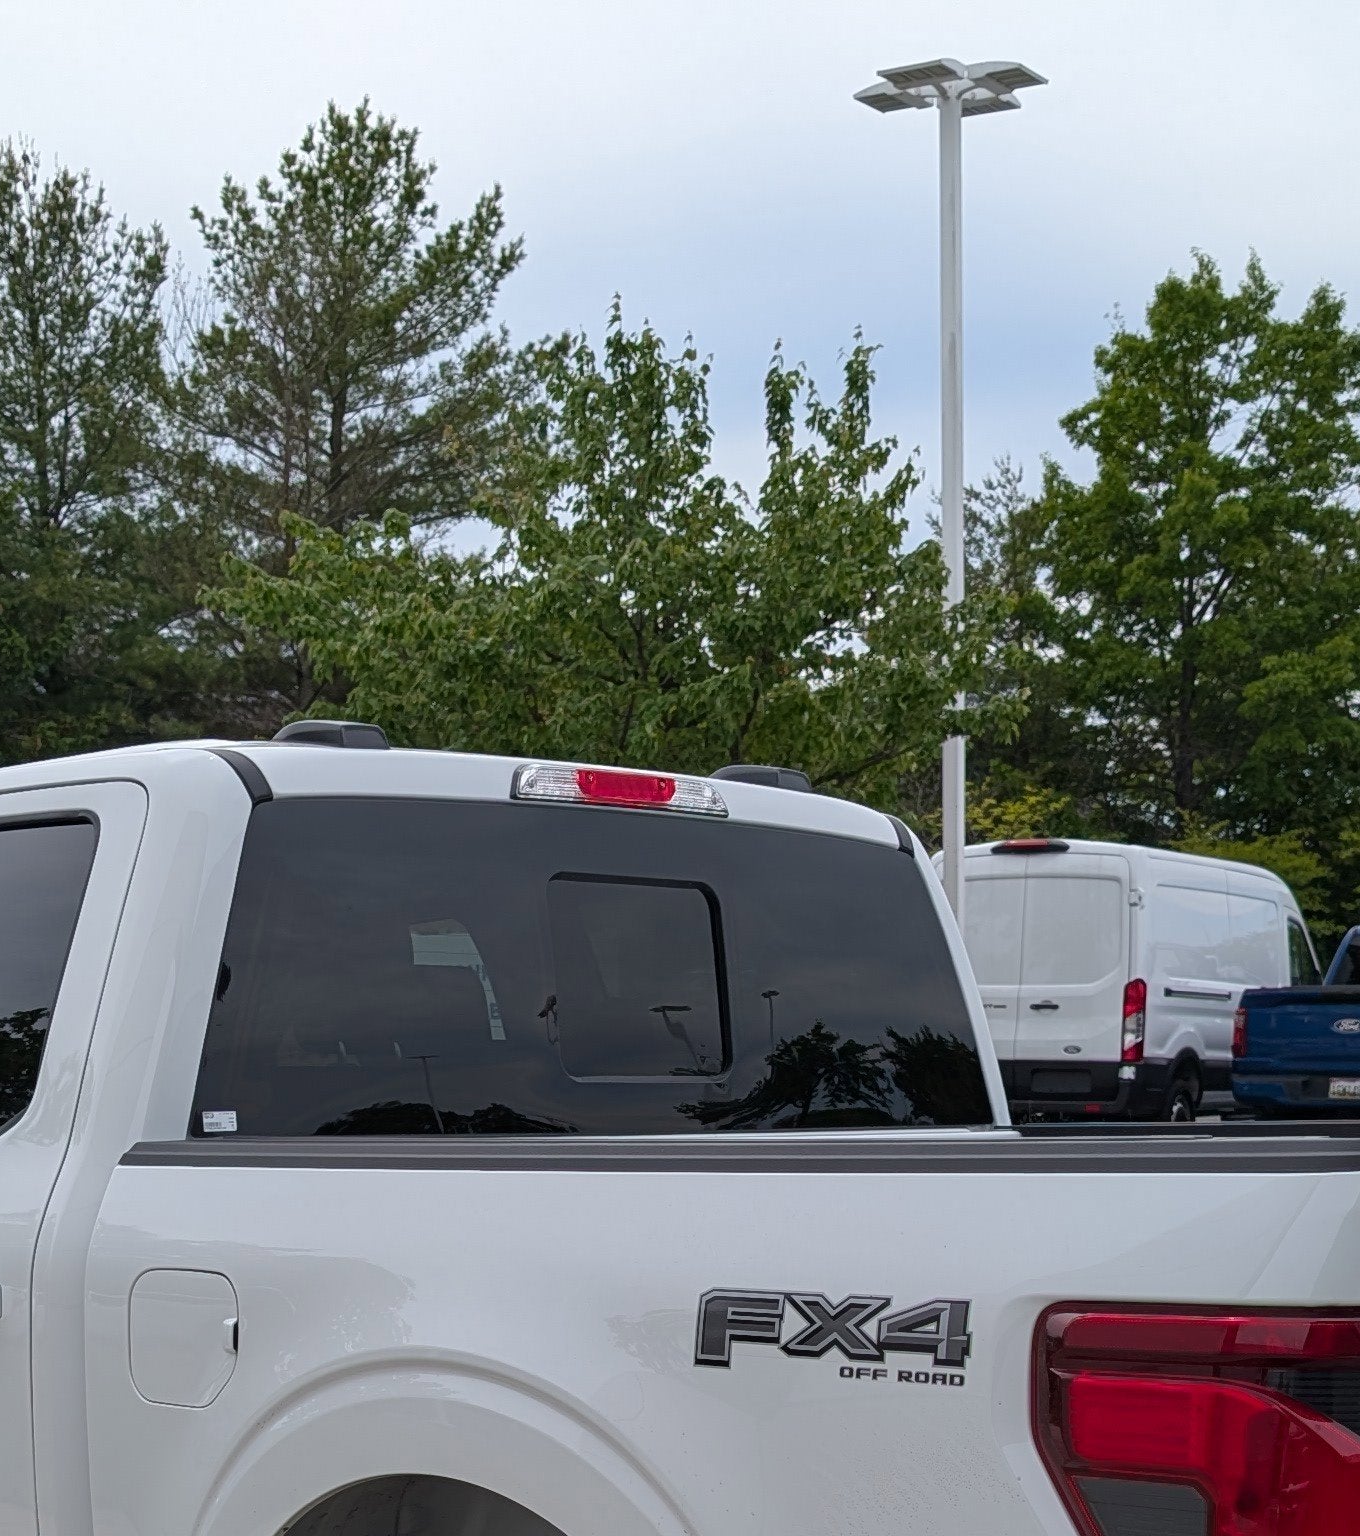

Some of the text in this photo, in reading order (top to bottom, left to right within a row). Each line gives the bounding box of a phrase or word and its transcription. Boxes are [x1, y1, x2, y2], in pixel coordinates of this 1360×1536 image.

[693, 1287, 972, 1369] FX4
[839, 1366, 966, 1387] OFF ROAD
